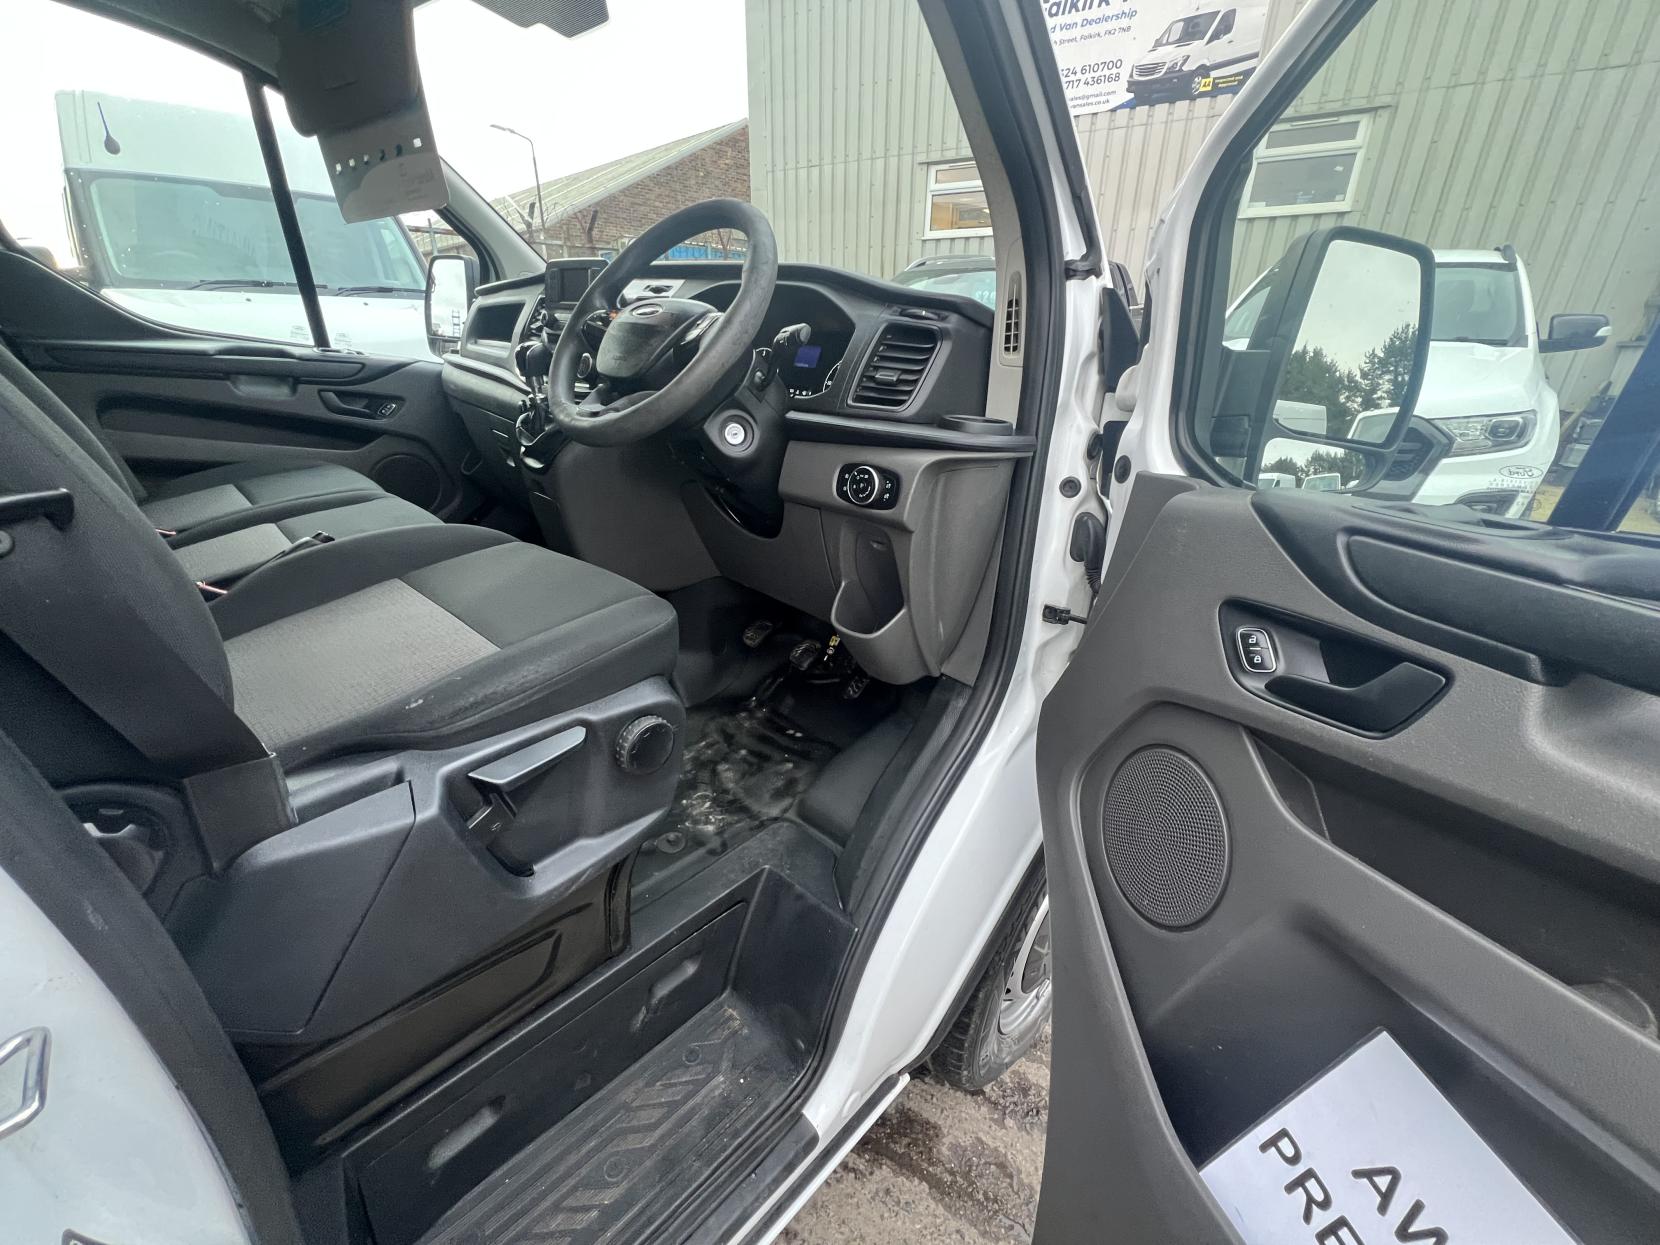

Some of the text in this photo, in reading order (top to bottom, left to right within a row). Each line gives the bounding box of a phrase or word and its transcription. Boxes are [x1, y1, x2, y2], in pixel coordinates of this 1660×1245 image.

[1060, 22, 1078, 32] Van
[1080, 8, 1138, 28] Dealership
[1061, 58, 1123, 78] 24 610700
[1083, 72, 1121, 87] 436168
